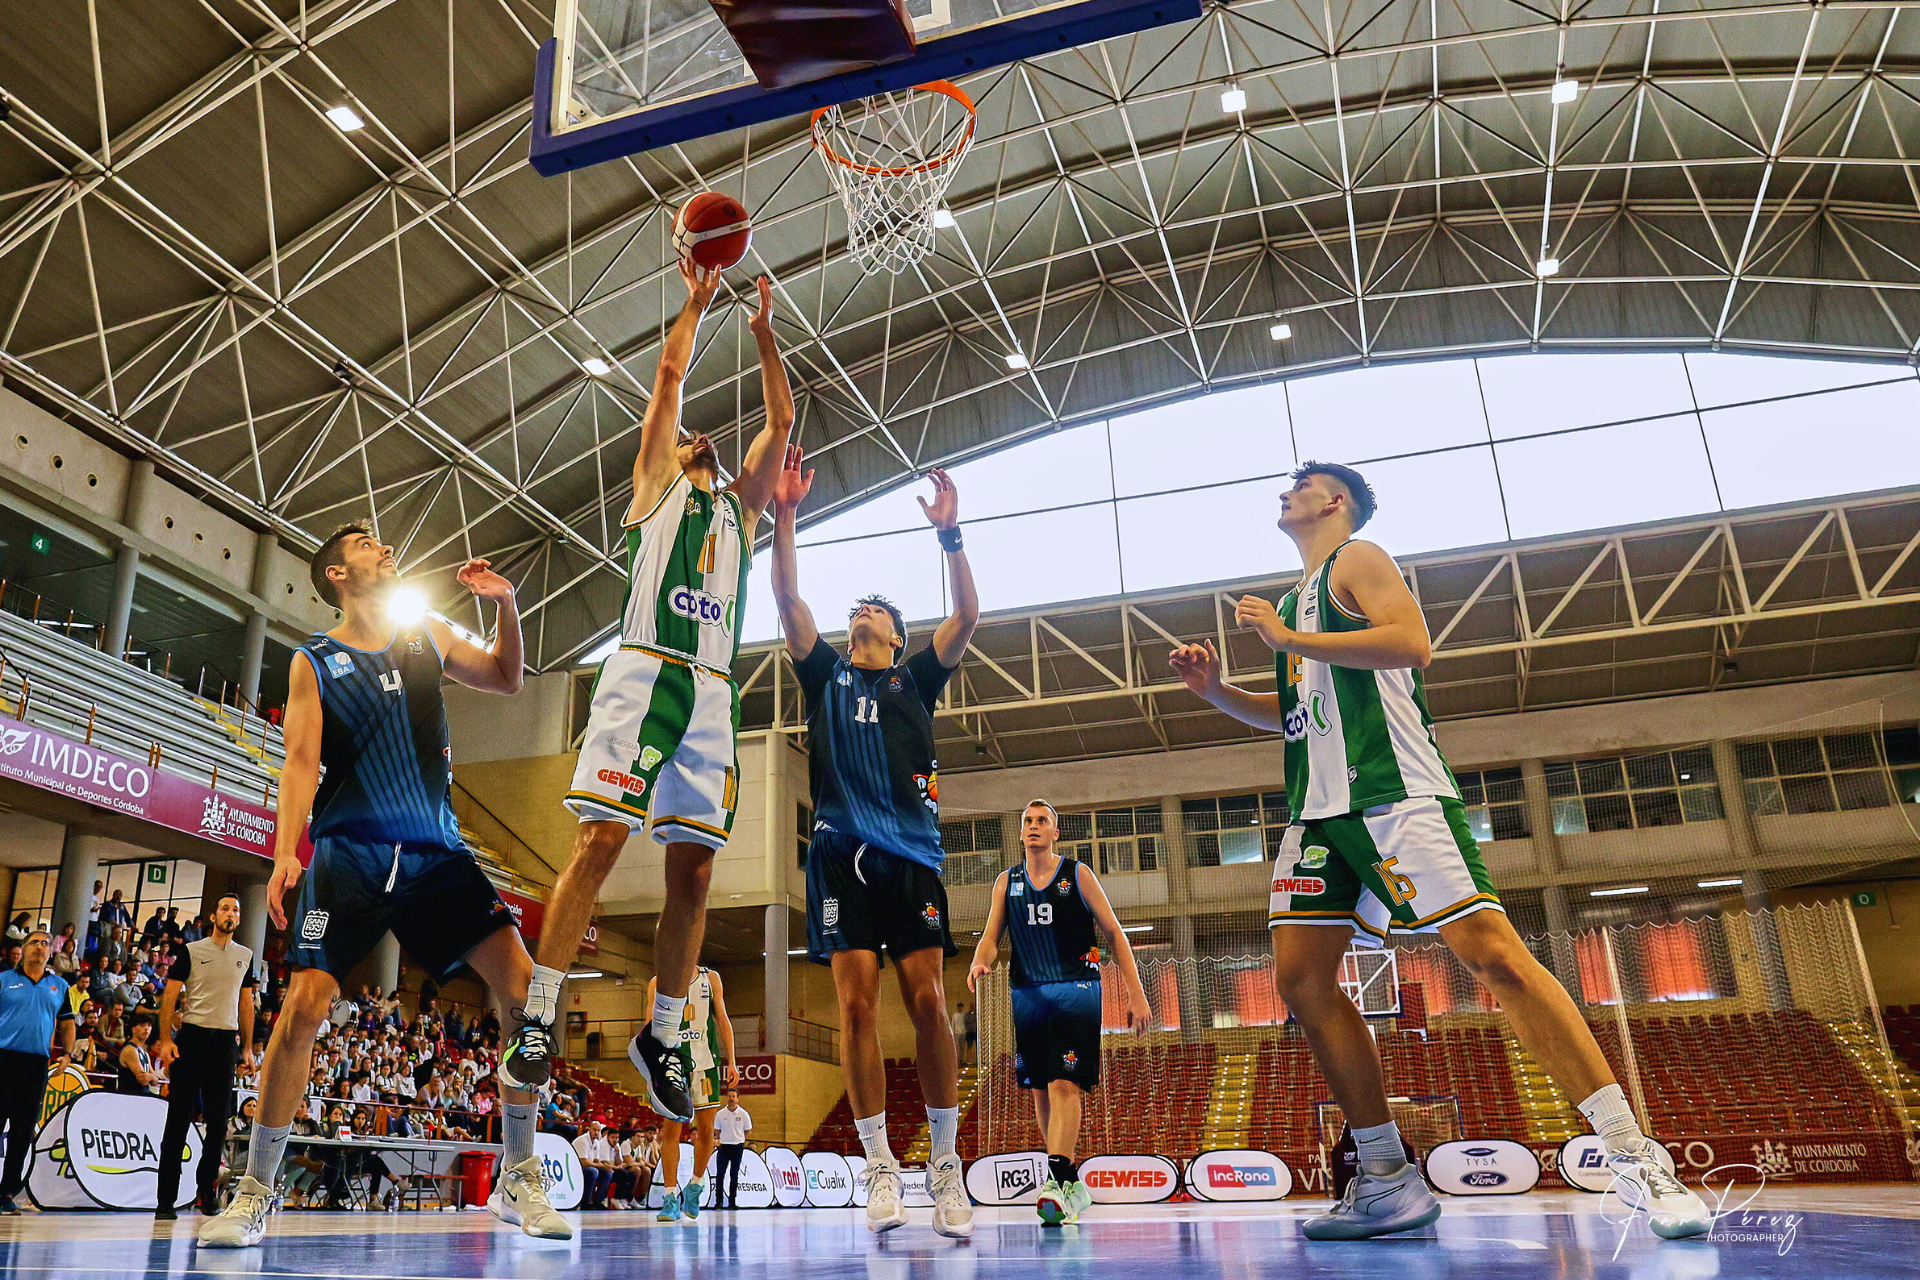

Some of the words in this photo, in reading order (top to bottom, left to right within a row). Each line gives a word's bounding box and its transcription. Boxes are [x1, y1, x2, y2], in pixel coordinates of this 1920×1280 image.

[35, 539, 43, 550] 4
[332, 666, 350, 677] EBA
[855, 696, 879, 724] 11
[30, 733, 150, 798] IMDECO
[0, 762, 24, 777] tituto
[24, 769, 65, 790] Municipal
[65, 783, 77, 794] de
[77, 786, 112, 805] Deportes
[113, 797, 144, 815] Córdoba
[228, 807, 275, 834] AYUNTAMIENTO
[226, 822, 236, 837] DE
[236, 825, 267, 847] CÓRDOBA
[153, 867, 161, 880] D
[1372, 856, 1417, 906] 15
[1027, 902, 1053, 926] 19
[1792, 1144, 1867, 1158] AYUNTAMIENTO
[1466, 1158, 1498, 1166] TYSA
[1795, 1161, 1806, 1173] DE
[816, 1170, 846, 1190] Cualix
[1001, 1168, 1030, 1188] RG3
[1469, 1172, 1499, 1185] Ford
